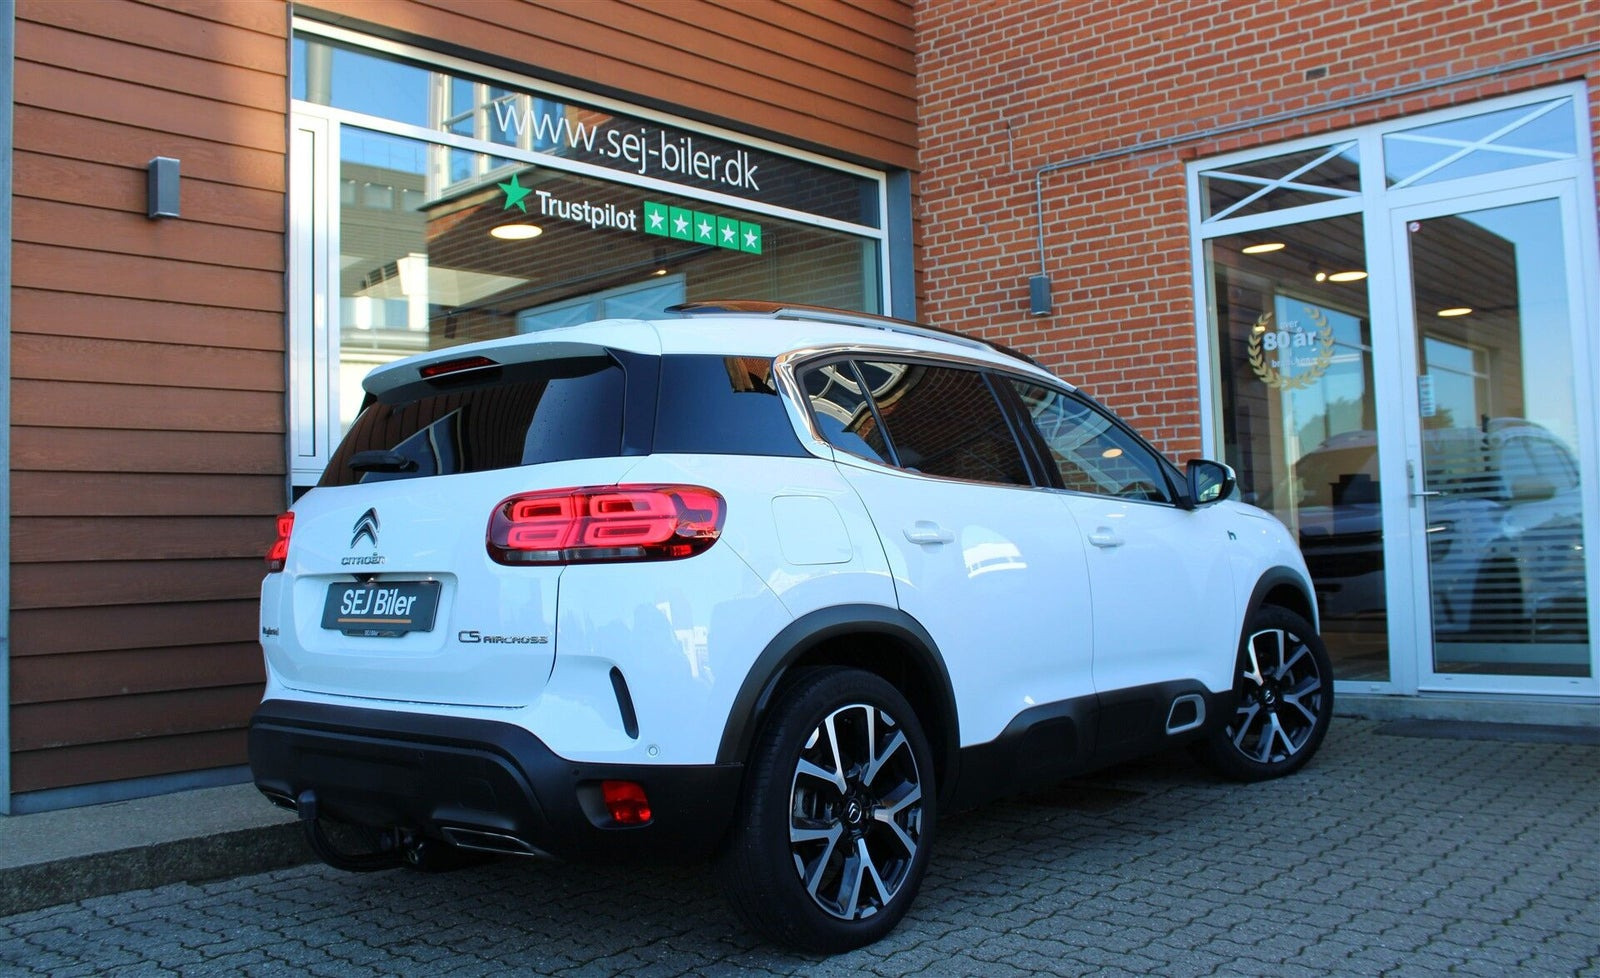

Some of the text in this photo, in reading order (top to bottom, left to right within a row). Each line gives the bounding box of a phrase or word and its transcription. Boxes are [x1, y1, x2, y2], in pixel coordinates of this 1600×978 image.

[494, 100, 760, 191] www.sej-biler.dk
[535, 189, 637, 231] Trustpilot
[1263, 326, 1316, 350] 80 år
[340, 588, 417, 616] SEJ Biler
[458, 631, 548, 644] C5 AIRCROSS
